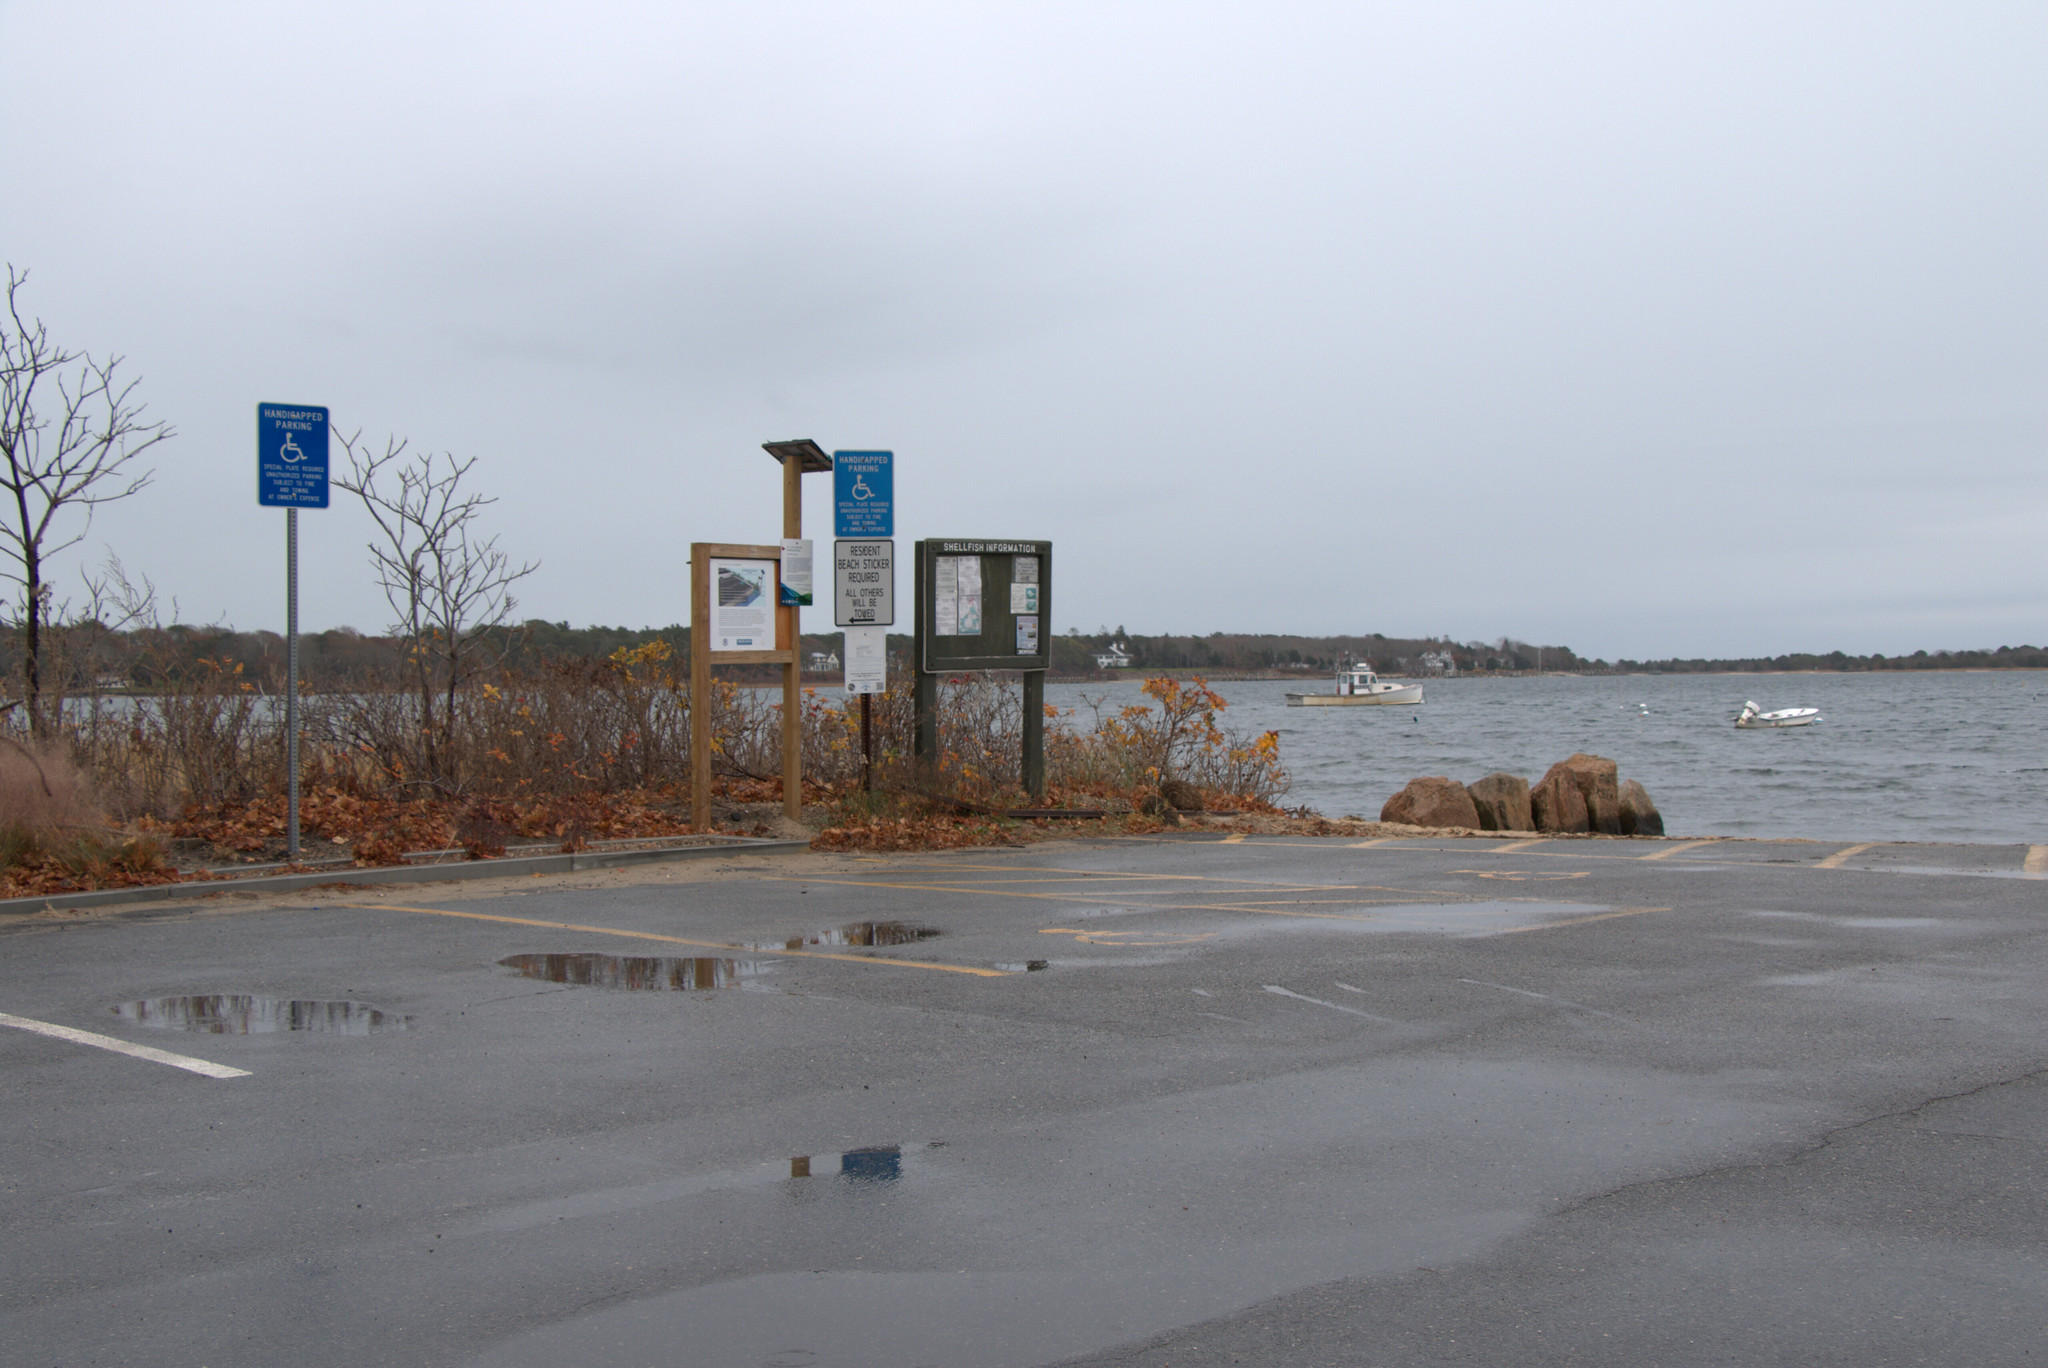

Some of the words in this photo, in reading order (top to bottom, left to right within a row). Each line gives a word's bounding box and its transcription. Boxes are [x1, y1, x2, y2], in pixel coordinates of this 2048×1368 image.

[264, 409, 323, 421] HANDICAPPED
[275, 420, 312, 431] PARKING
[839, 456, 888, 464] HANDICAPPED
[848, 464, 879, 472] PARKING
[850, 546, 880, 556] RESIDENT
[943, 542, 984, 552] SHELLFISH
[986, 543, 1036, 553] INFORMATION
[838, 558, 860, 570] BEACH
[863, 558, 890, 570] STICKER
[848, 572, 880, 583] REQUIRED
[846, 588, 856, 598] ALL
[860, 588, 884, 598] OTHERS
[852, 598, 866, 607] WILL
[869, 598, 877, 607] BE
[854, 608, 875, 618] TOWED
